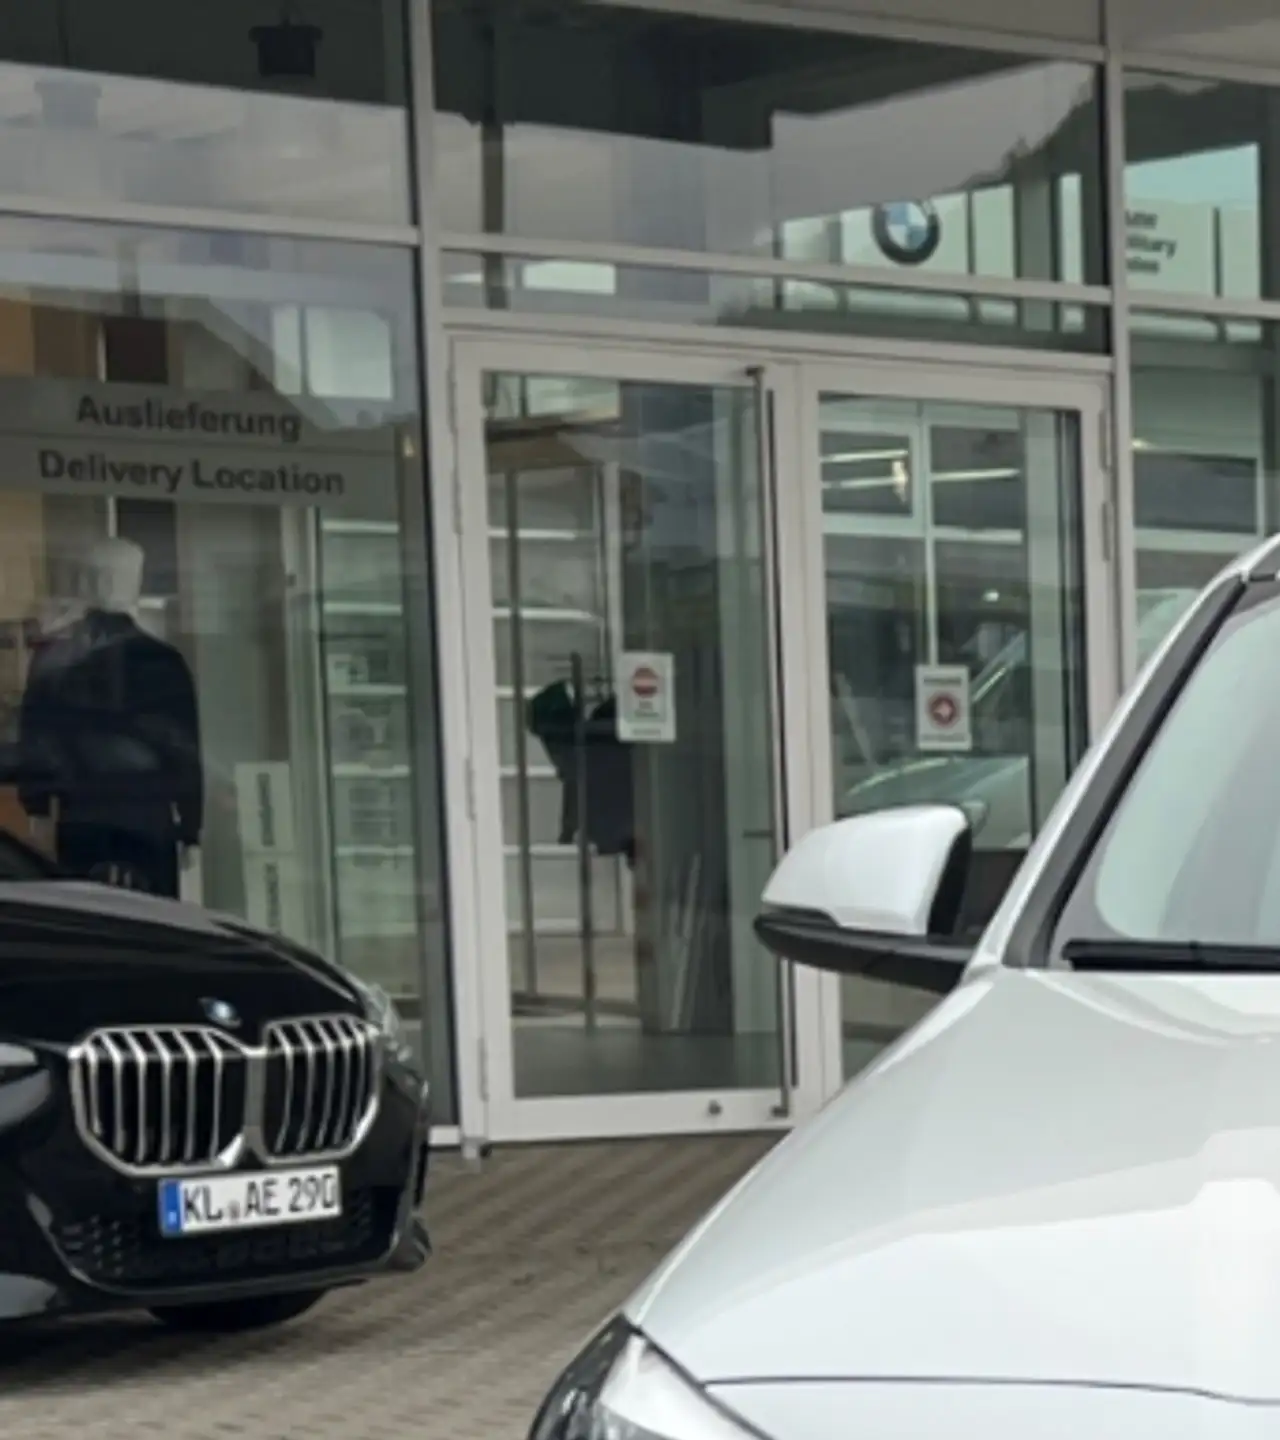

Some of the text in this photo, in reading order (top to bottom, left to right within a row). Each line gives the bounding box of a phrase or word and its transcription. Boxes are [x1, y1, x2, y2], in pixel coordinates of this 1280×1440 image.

[77, 396, 302, 441] Auslieferung
[39, 449, 345, 495] Delivery Location
